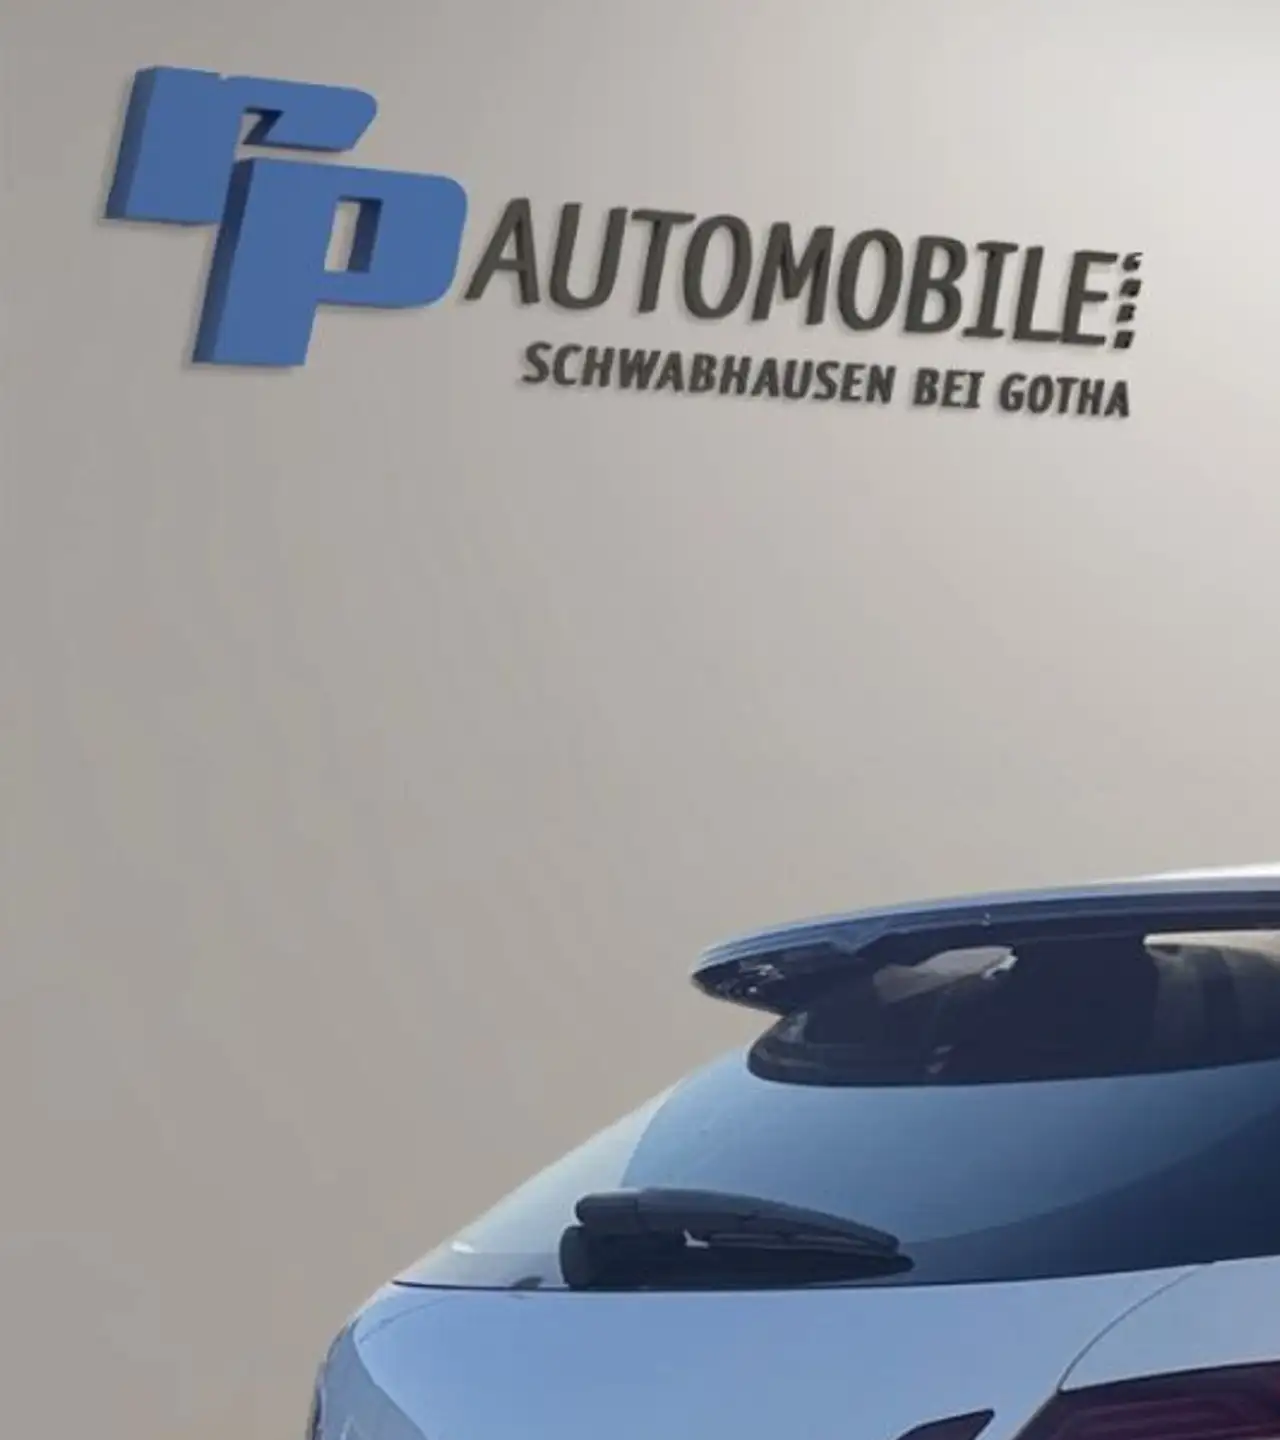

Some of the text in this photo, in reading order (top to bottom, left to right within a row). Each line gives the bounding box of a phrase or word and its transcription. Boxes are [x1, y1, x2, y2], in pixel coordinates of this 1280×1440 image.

[462, 196, 1119, 348] AUTOMOBILE
[521, 342, 1130, 418] SCHWABHAUSEN BEI GOTHA
